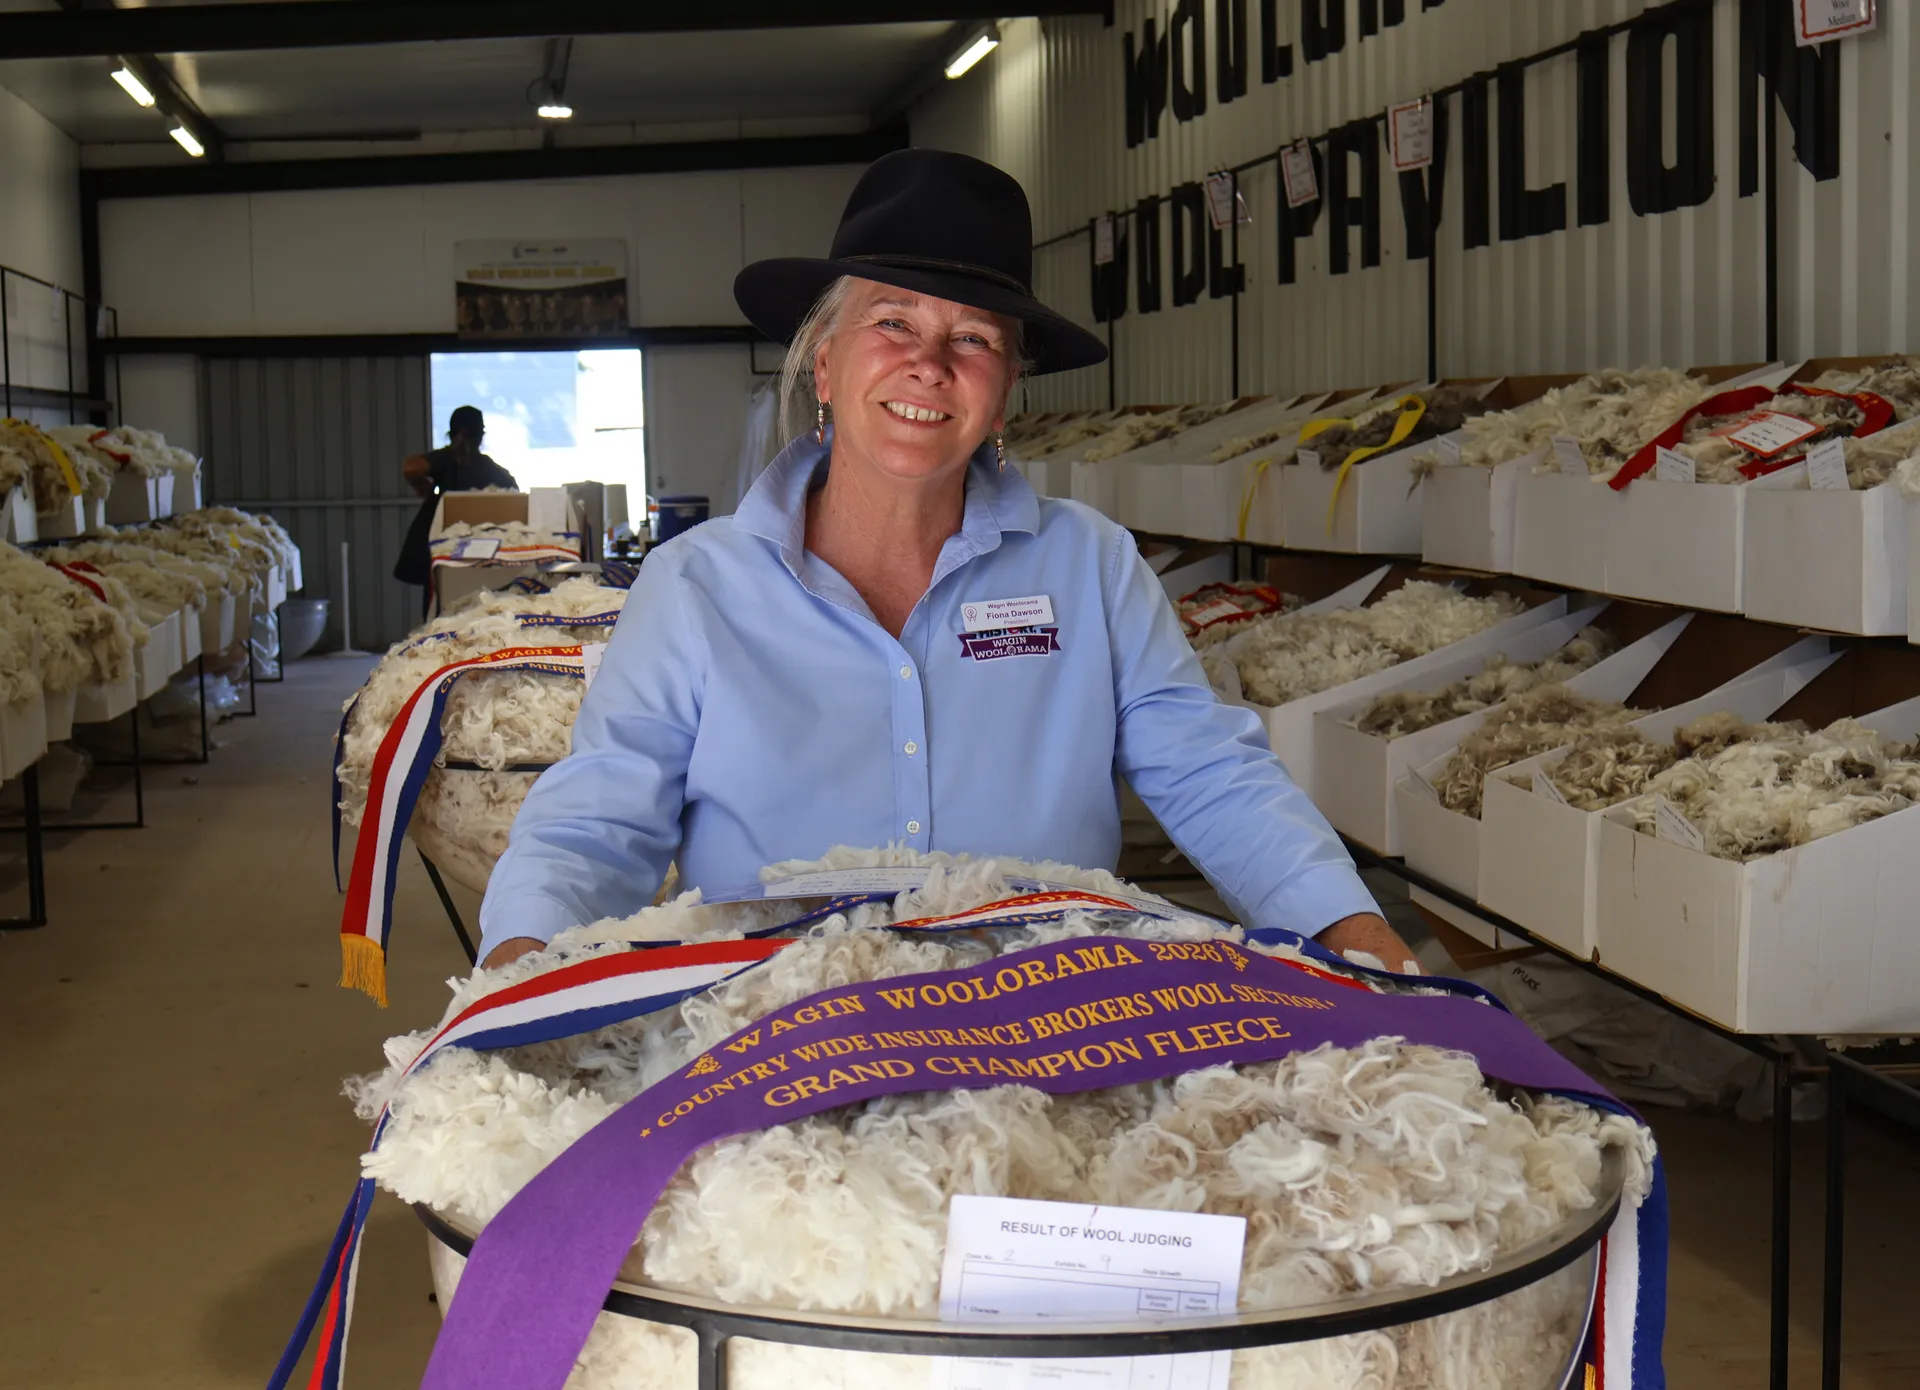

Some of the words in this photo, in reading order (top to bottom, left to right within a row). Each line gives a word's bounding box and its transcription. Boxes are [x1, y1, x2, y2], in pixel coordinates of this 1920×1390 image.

[986, 611, 1010, 619] Fiona
[1011, 608, 1043, 617] Dawson
[987, 602, 1006, 610] Wagin
[1006, 599, 1038, 608] Woolorama
[992, 636, 1027, 648] WAGIN
[495, 648, 553, 660] WAGIN
[726, 993, 867, 1055] WAGIN
[877, 944, 1144, 1011] WOOLORAMA
[1147, 942, 1224, 964] 2026
[656, 1054, 791, 1130] COUNTRY
[793, 1033, 873, 1063] WIDE
[873, 1021, 1031, 1050] INSURANCE
[1029, 992, 1154, 1040] BROKERS
[1152, 982, 1236, 1014] WOOL
[1231, 982, 1325, 1011] SECTION
[765, 1058, 916, 1107] GRAND
[926, 1036, 1144, 1078] CHAMPION
[1145, 1017, 1292, 1057] FLEECE
[1001, 1221, 1056, 1236] RESULT
[1059, 1226, 1078, 1238] OF
[1083, 1228, 1125, 1243] WOOL
[1129, 1233, 1193, 1248] JUDGING
